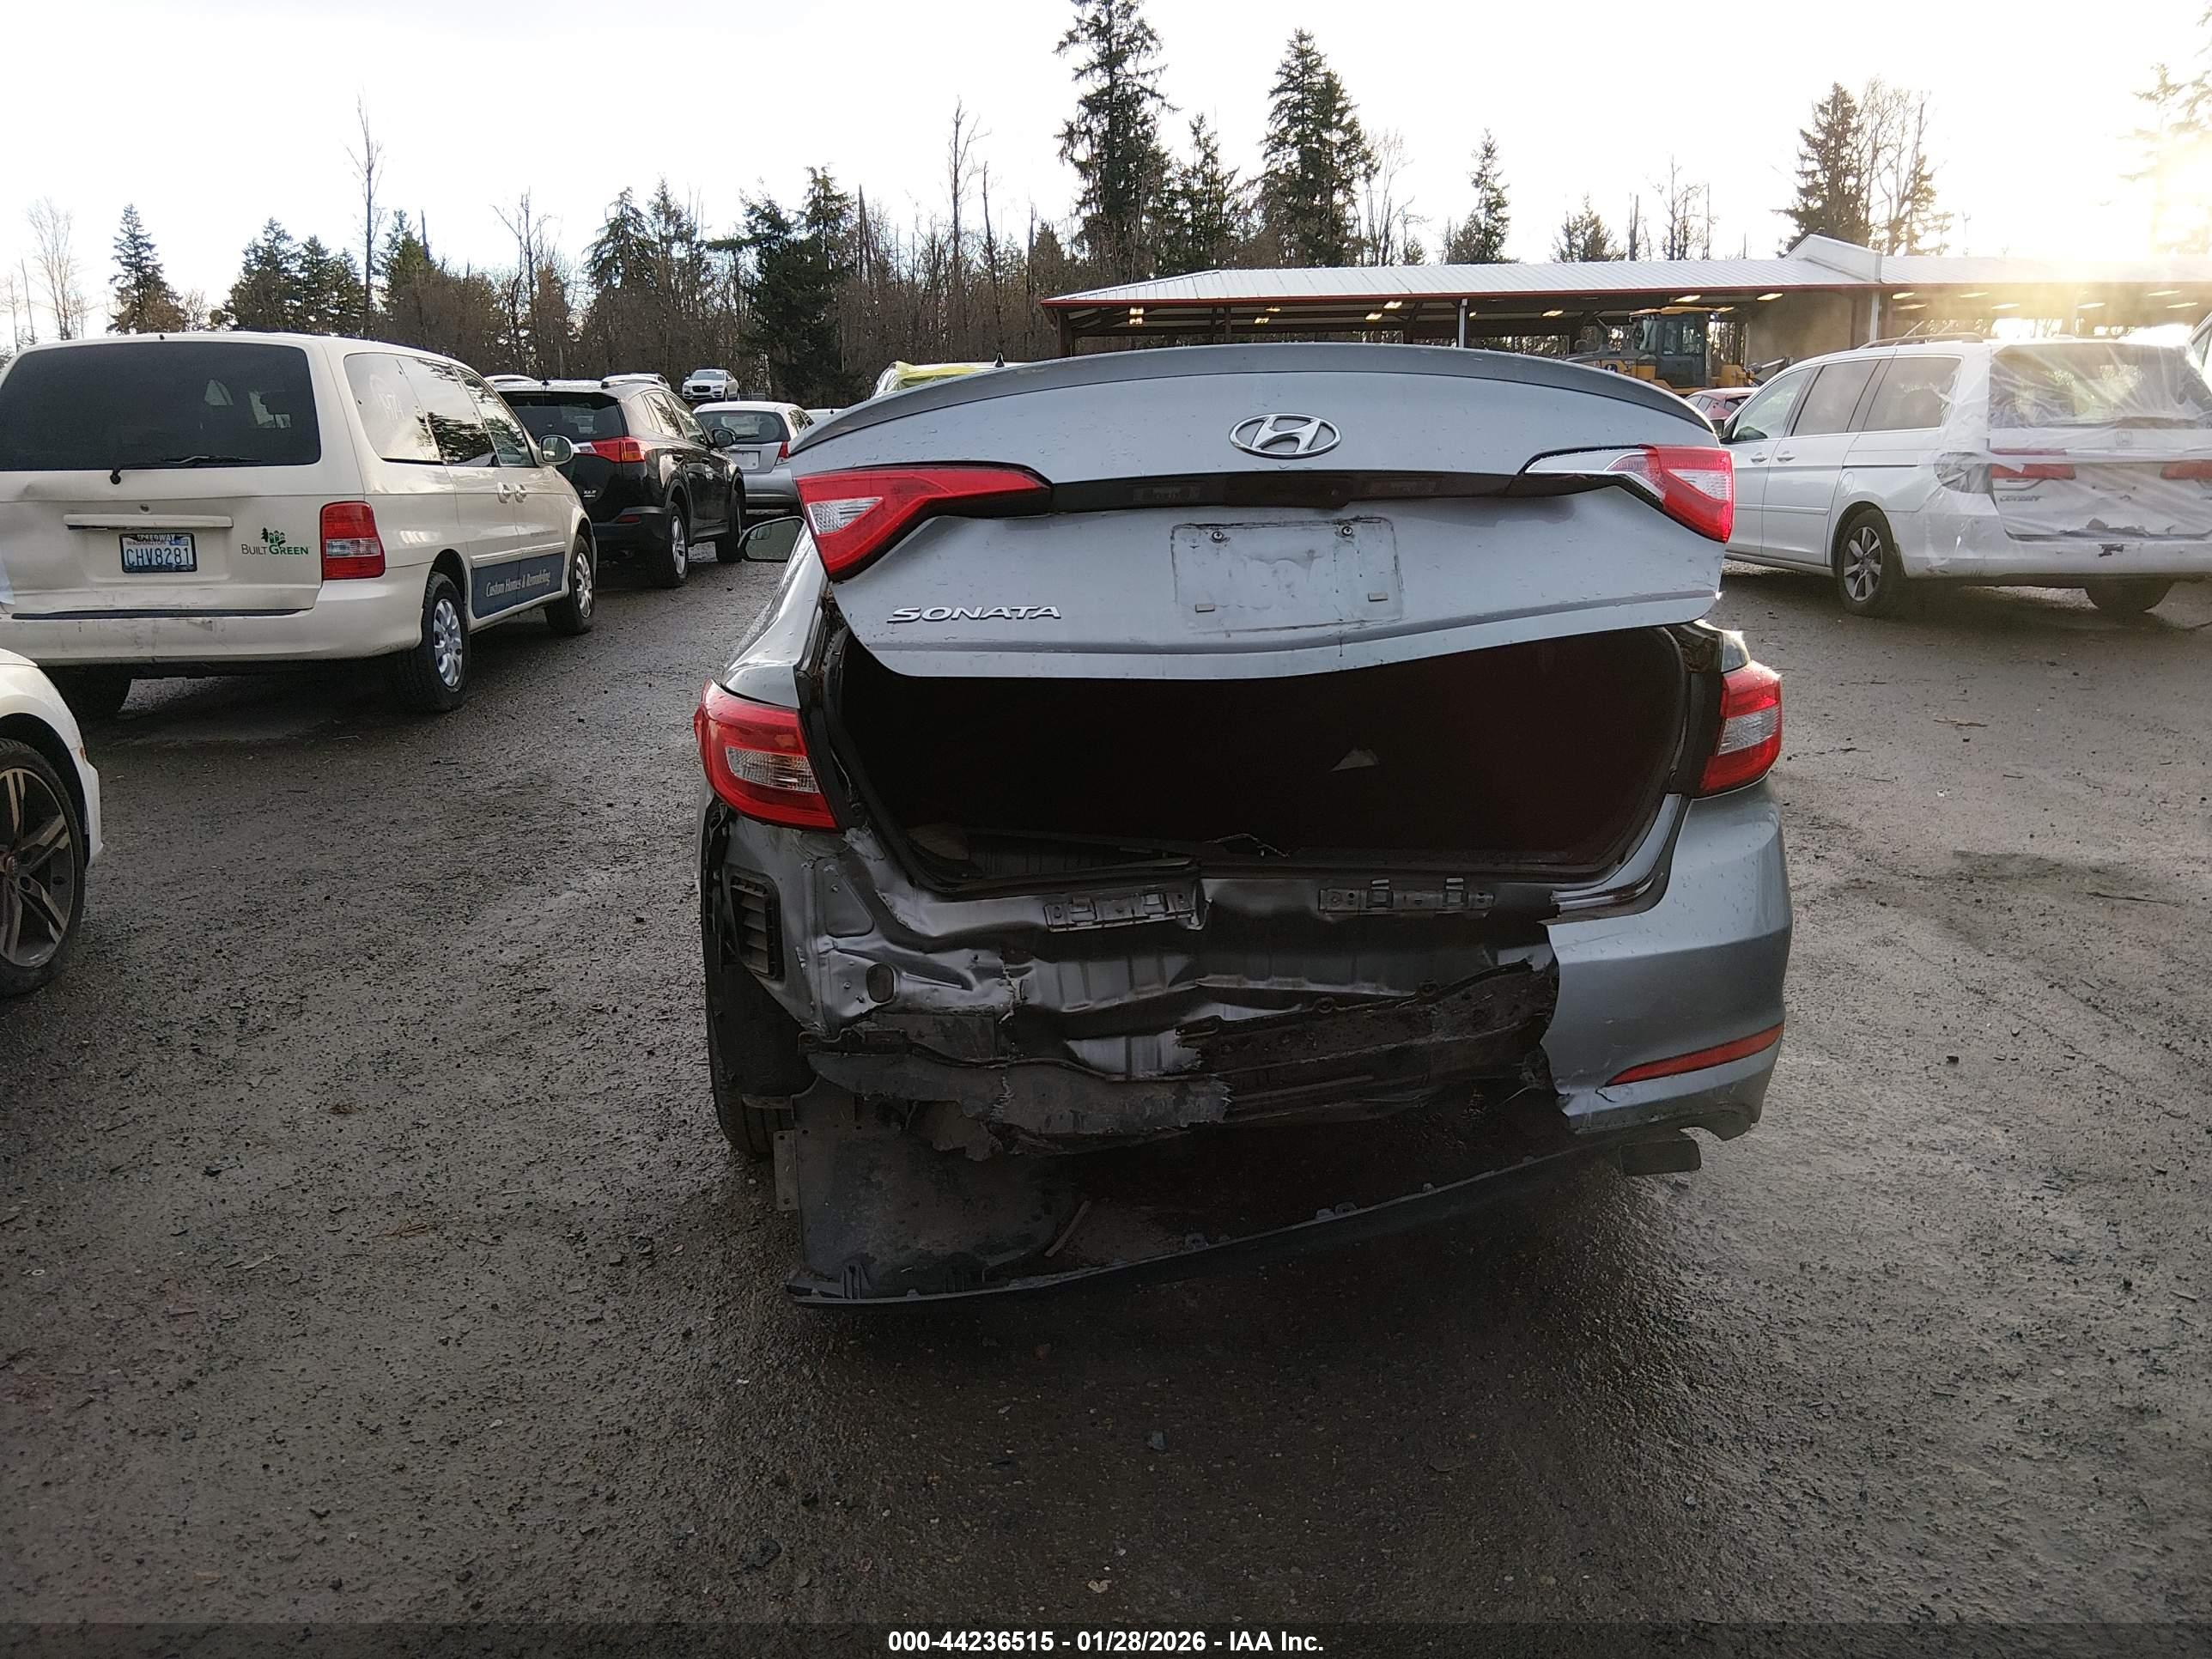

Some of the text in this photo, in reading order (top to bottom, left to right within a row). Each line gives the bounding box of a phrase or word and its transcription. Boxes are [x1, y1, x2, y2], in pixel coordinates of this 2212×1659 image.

[126, 547, 189, 566] CHV8281
[486, 581, 505, 598] Custom
[505, 578, 521, 592] Homes
[526, 568, 551, 586] Remodeling
[886, 606, 1061, 623] SONATA
